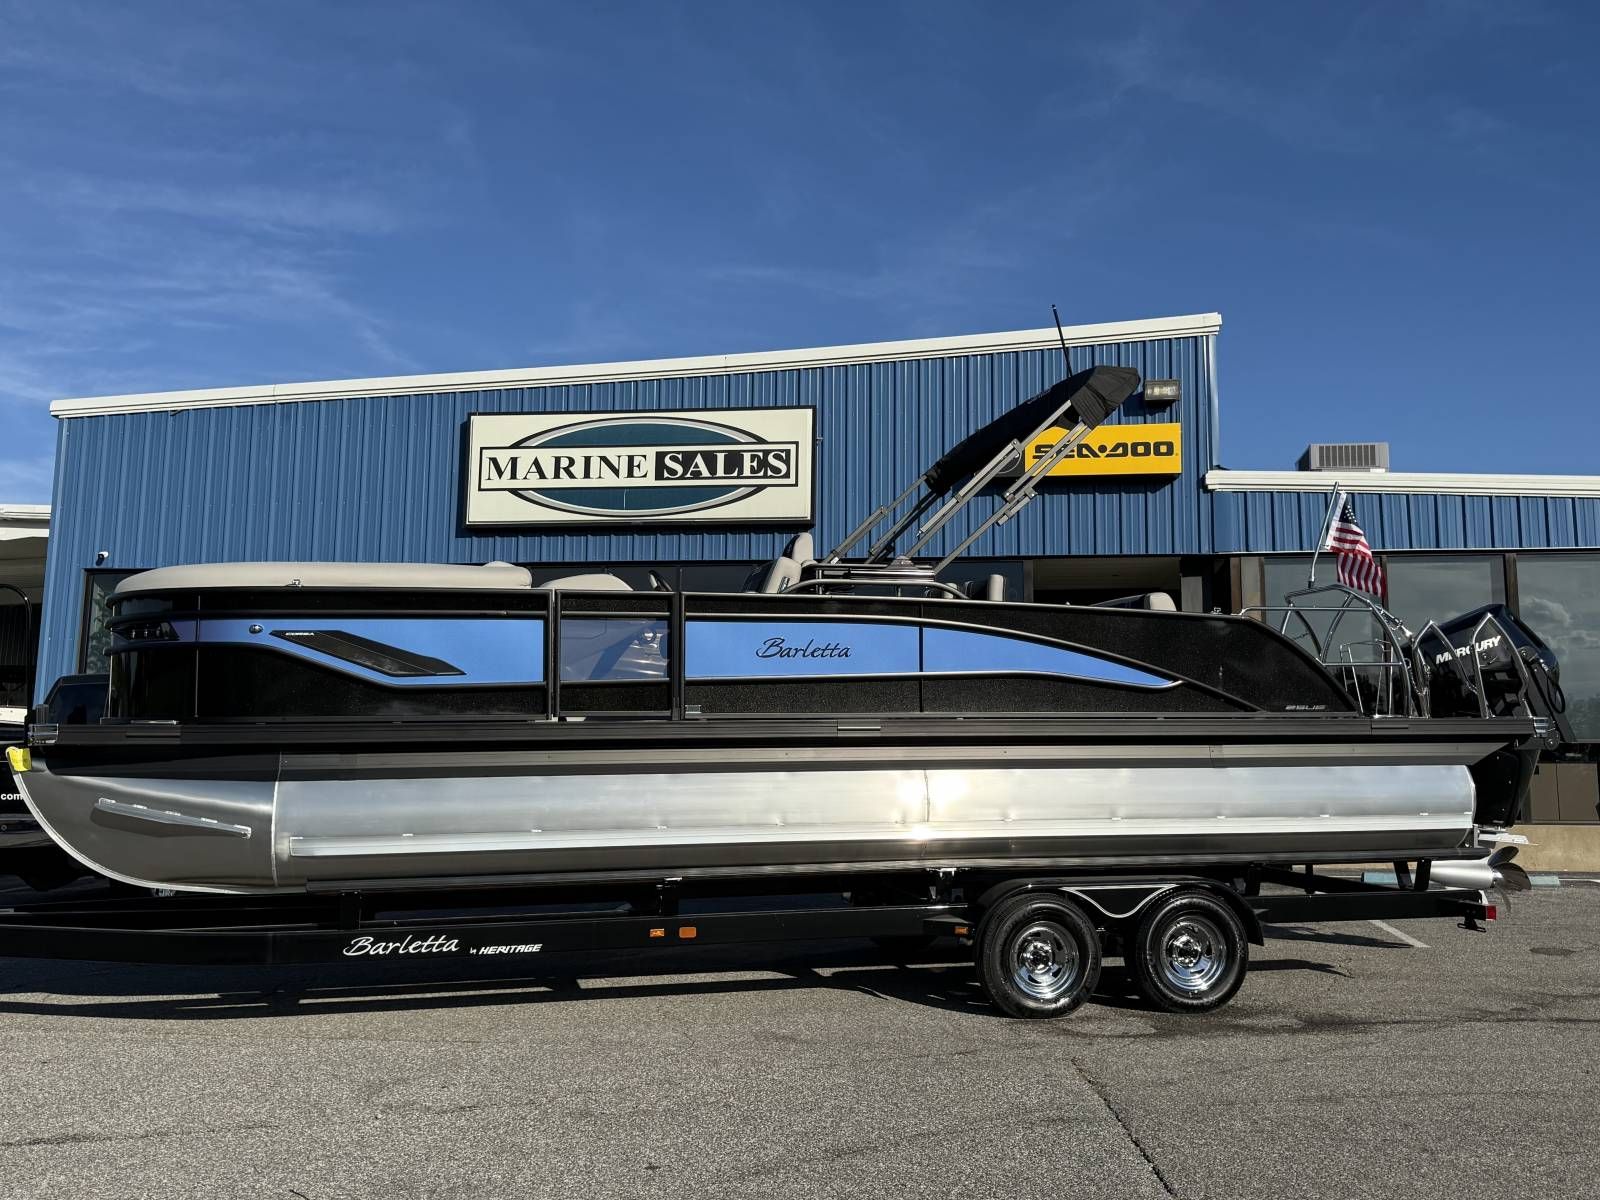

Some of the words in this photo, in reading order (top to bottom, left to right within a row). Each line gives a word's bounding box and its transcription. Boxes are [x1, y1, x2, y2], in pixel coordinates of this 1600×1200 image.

[485, 454, 648, 481] MARINE
[664, 450, 788, 479] SALES
[755, 637, 851, 658] Barletta
[1435, 635, 1501, 665] MRCURY
[343, 935, 460, 956] Barletta
[478, 944, 543, 955] HERITAGE
